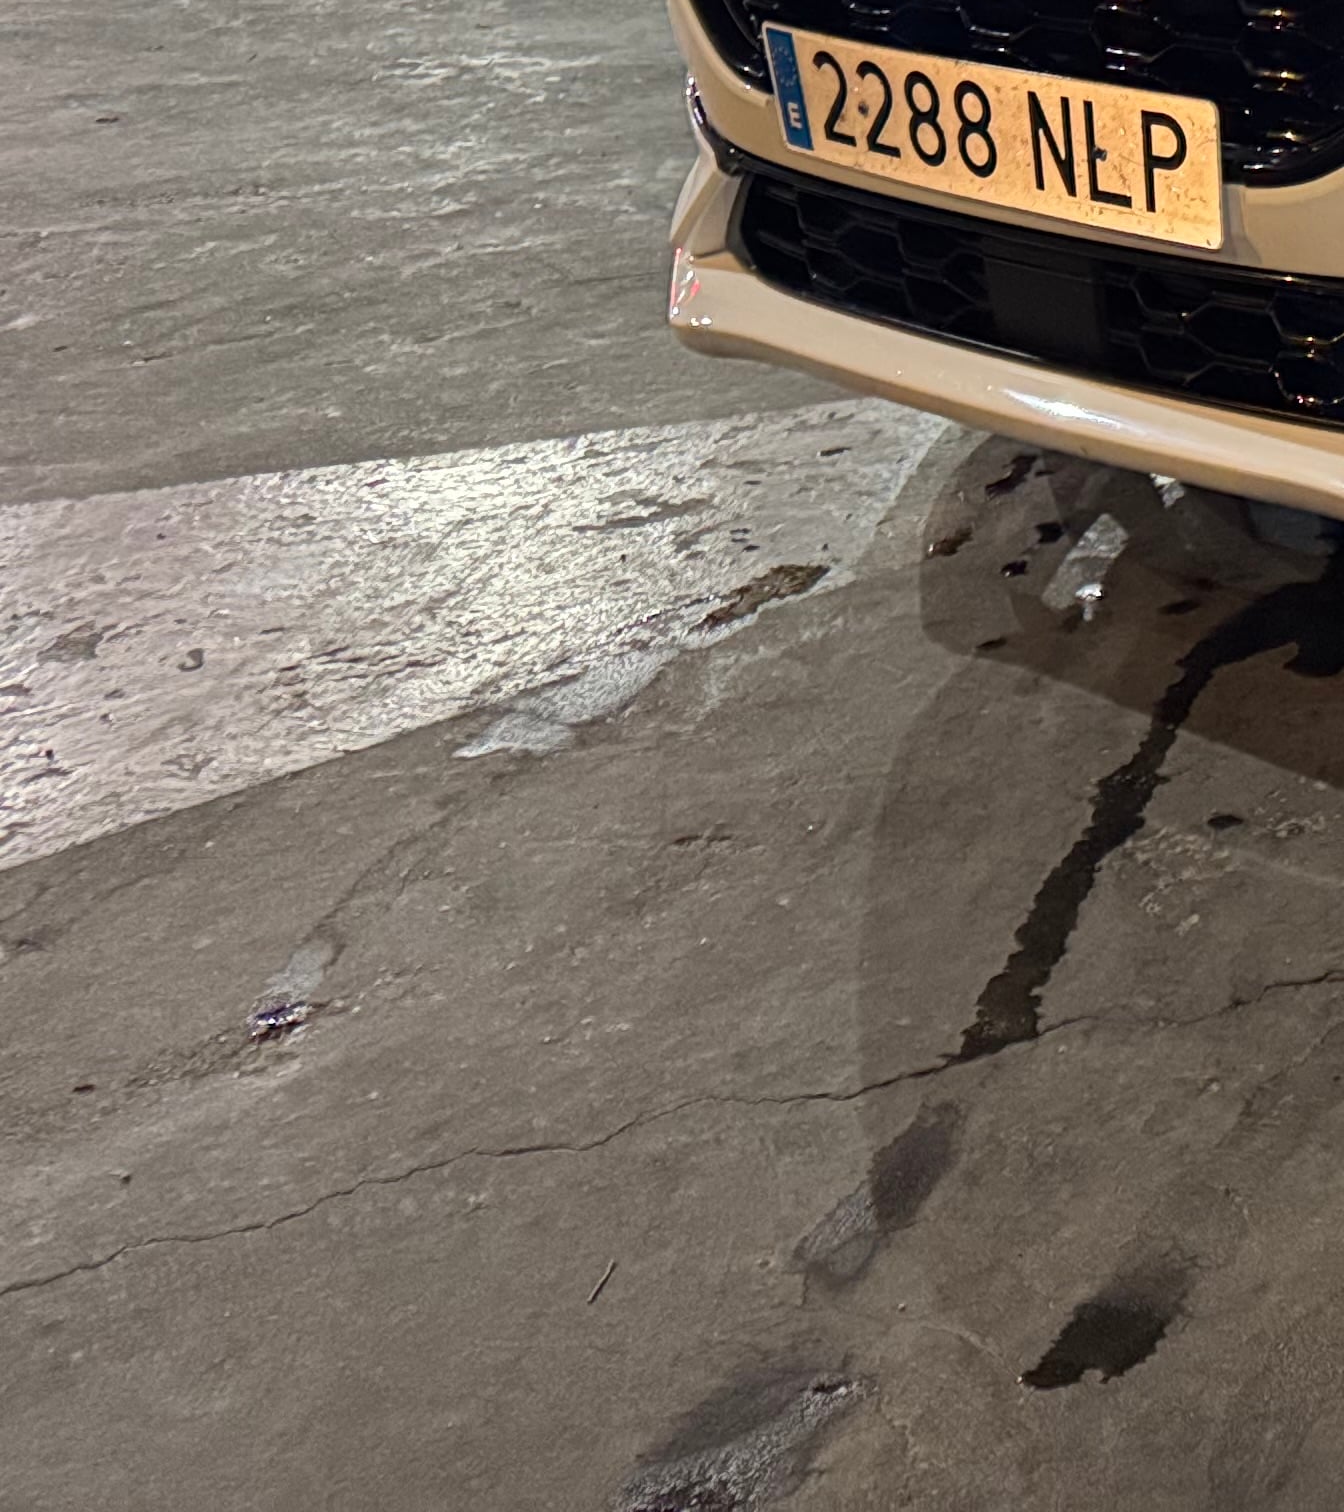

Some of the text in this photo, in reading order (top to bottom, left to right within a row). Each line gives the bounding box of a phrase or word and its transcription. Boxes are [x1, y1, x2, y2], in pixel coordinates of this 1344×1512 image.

[786, 101, 803, 130] E
[812, 50, 1188, 213] 2288 NLP
